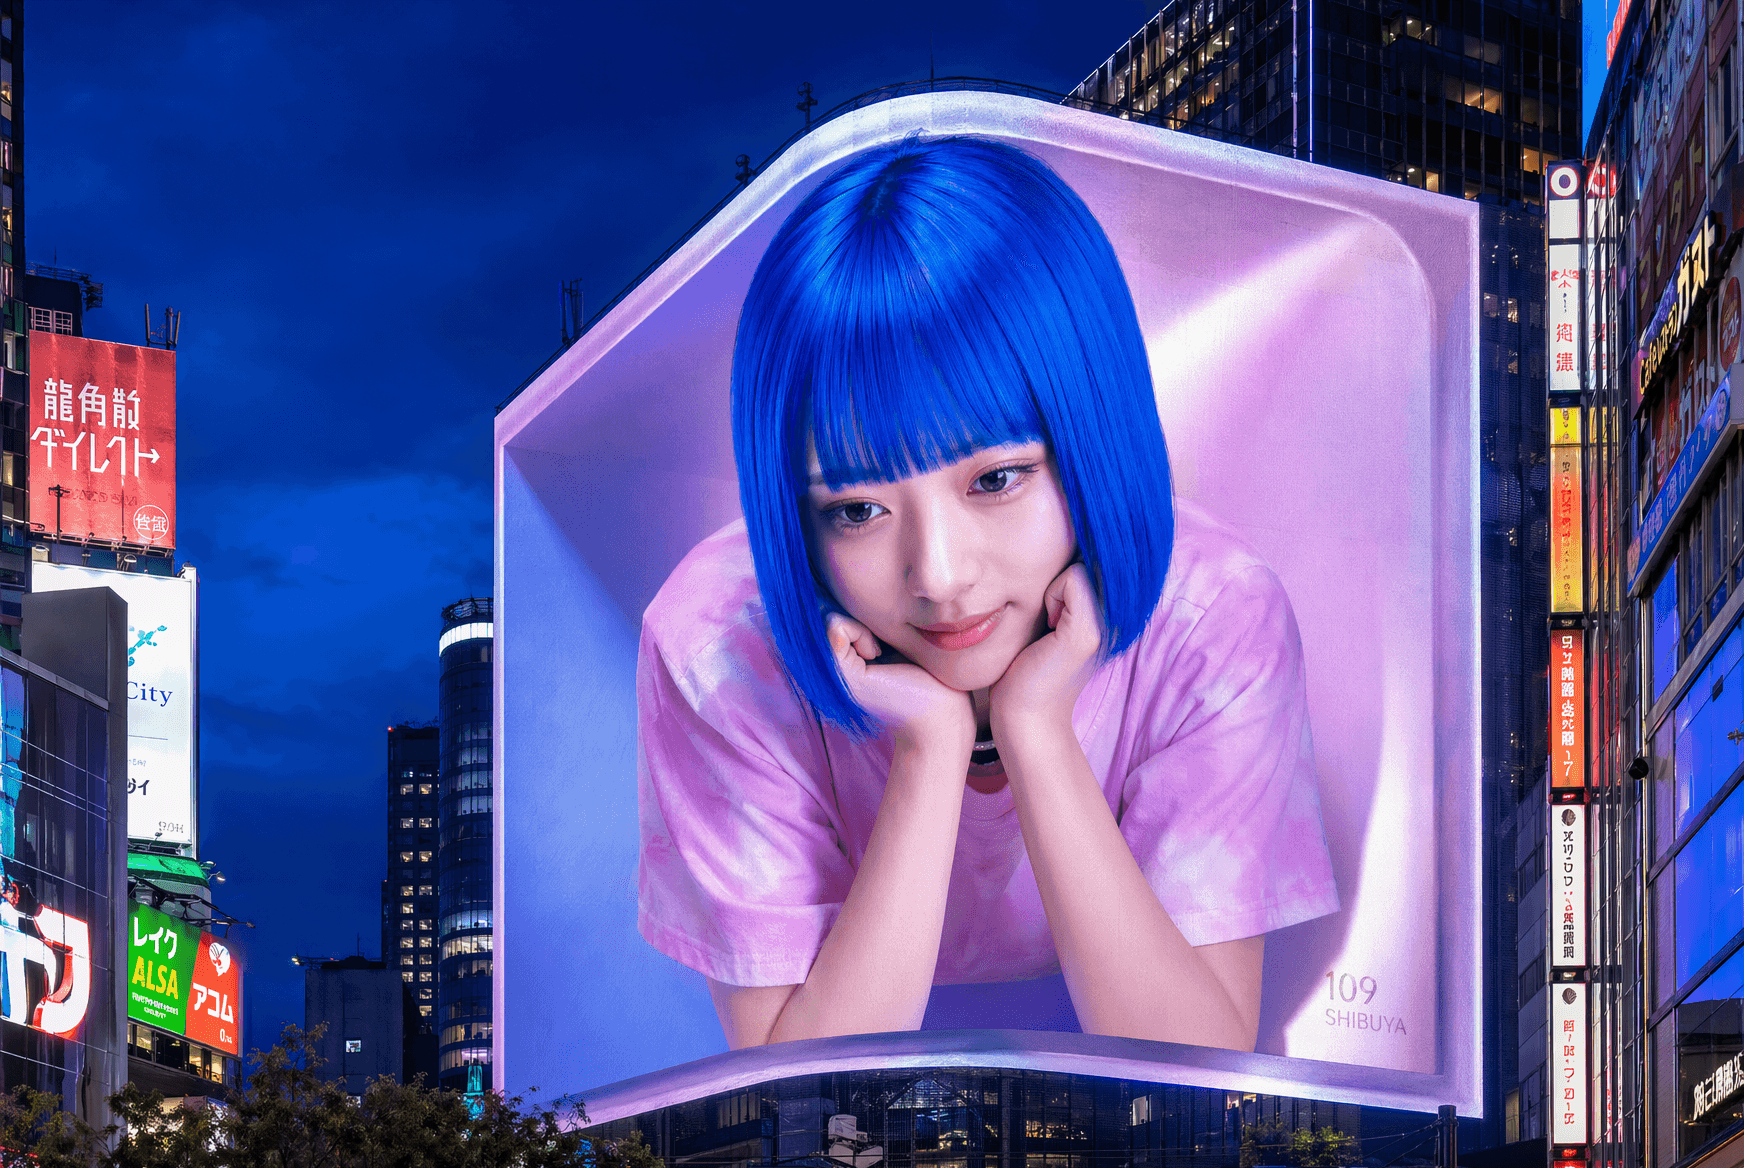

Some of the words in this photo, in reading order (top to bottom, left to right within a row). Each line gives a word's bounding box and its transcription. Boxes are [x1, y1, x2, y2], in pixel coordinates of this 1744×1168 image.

[44, 377, 141, 430] 龍角散
[30, 427, 160, 477] ダイレクト
[127, 681, 173, 707] City
[133, 916, 178, 960] レイク
[132, 955, 179, 1000] ALSA
[1325, 971, 1378, 1005] 109
[192, 982, 234, 1024] アコム
[1325, 1008, 1407, 1035] SHIBUYA
